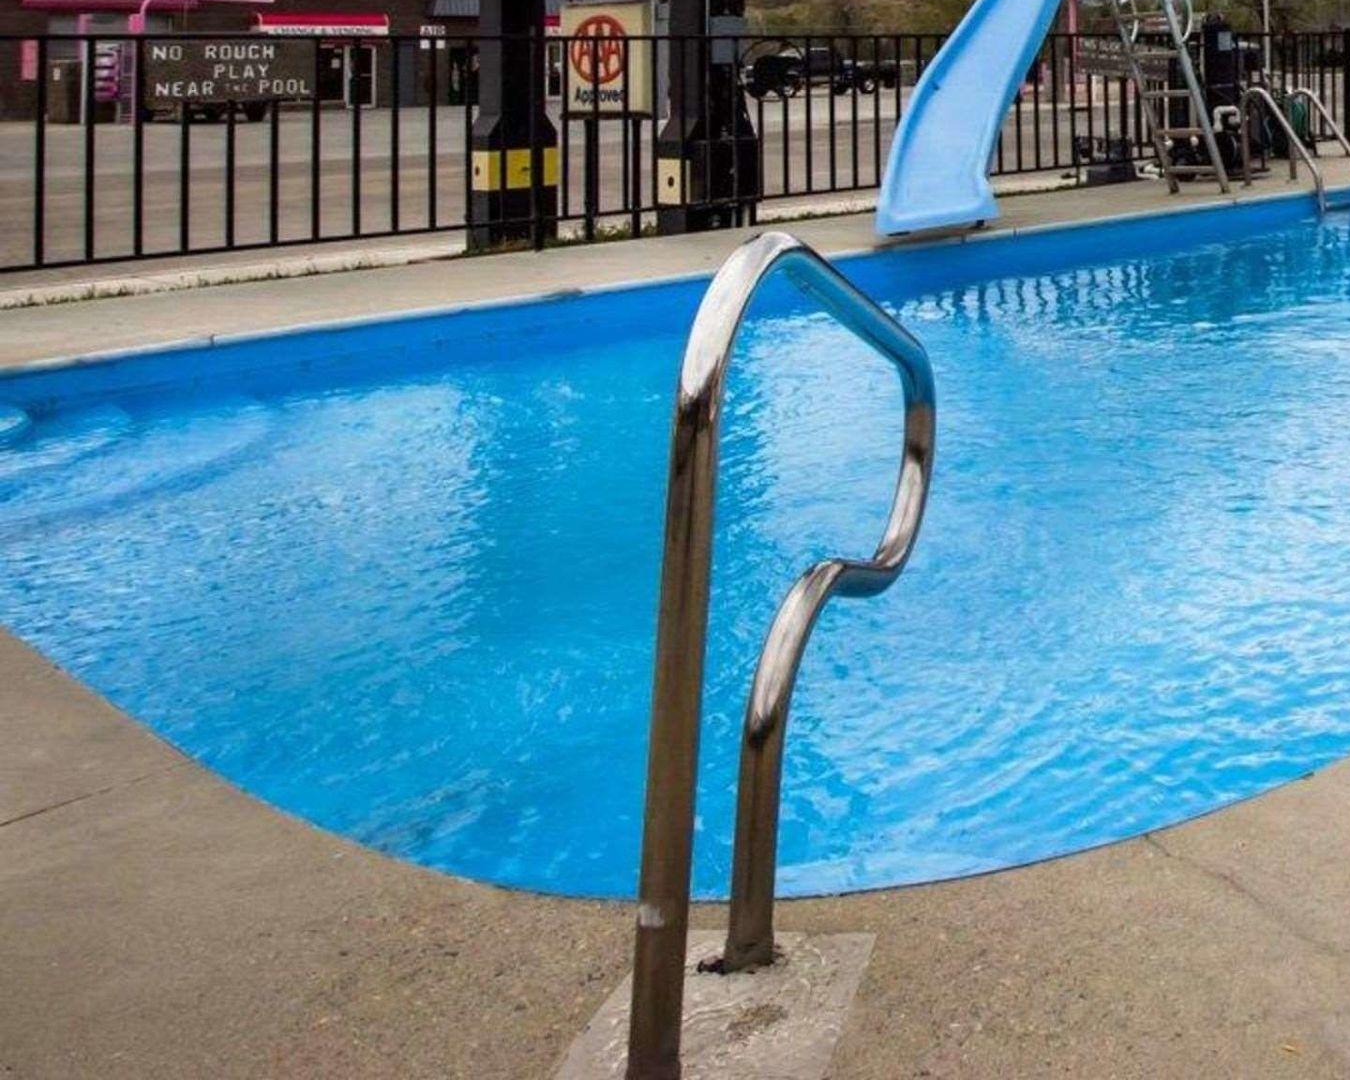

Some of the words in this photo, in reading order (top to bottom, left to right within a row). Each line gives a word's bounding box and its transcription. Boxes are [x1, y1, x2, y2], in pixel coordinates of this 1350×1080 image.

[152, 45, 183, 60] NO
[213, 63, 269, 79] PLAY
[155, 80, 215, 97] NEAR
[259, 78, 311, 95] POOL
